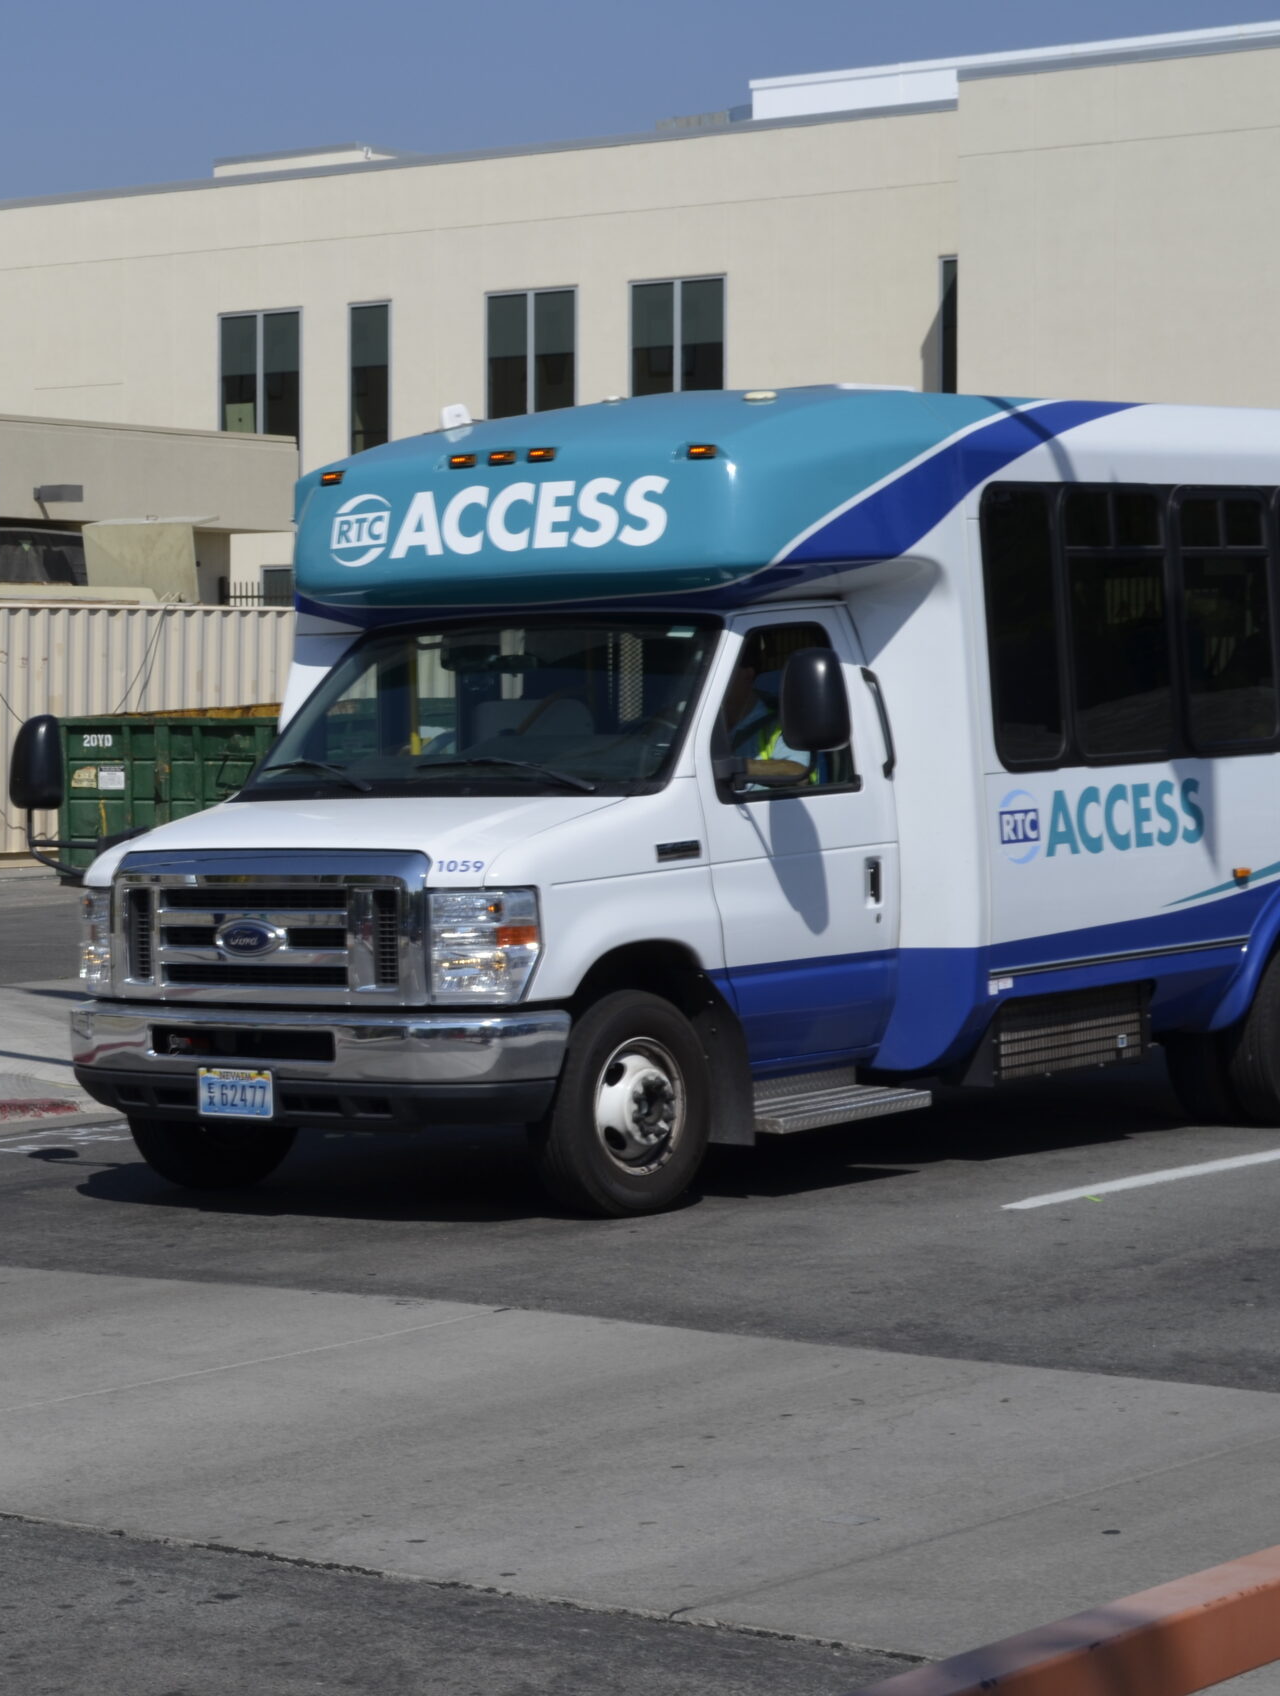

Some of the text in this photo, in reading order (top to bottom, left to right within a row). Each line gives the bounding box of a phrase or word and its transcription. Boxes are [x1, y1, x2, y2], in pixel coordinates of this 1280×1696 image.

[336, 475, 670, 560] RTC ACCESS
[83, 734, 113, 748] 20YD
[1002, 778, 1205, 858] RTC ACCESS
[437, 860, 485, 873] 1059
[221, 1083, 267, 1109] 62477
